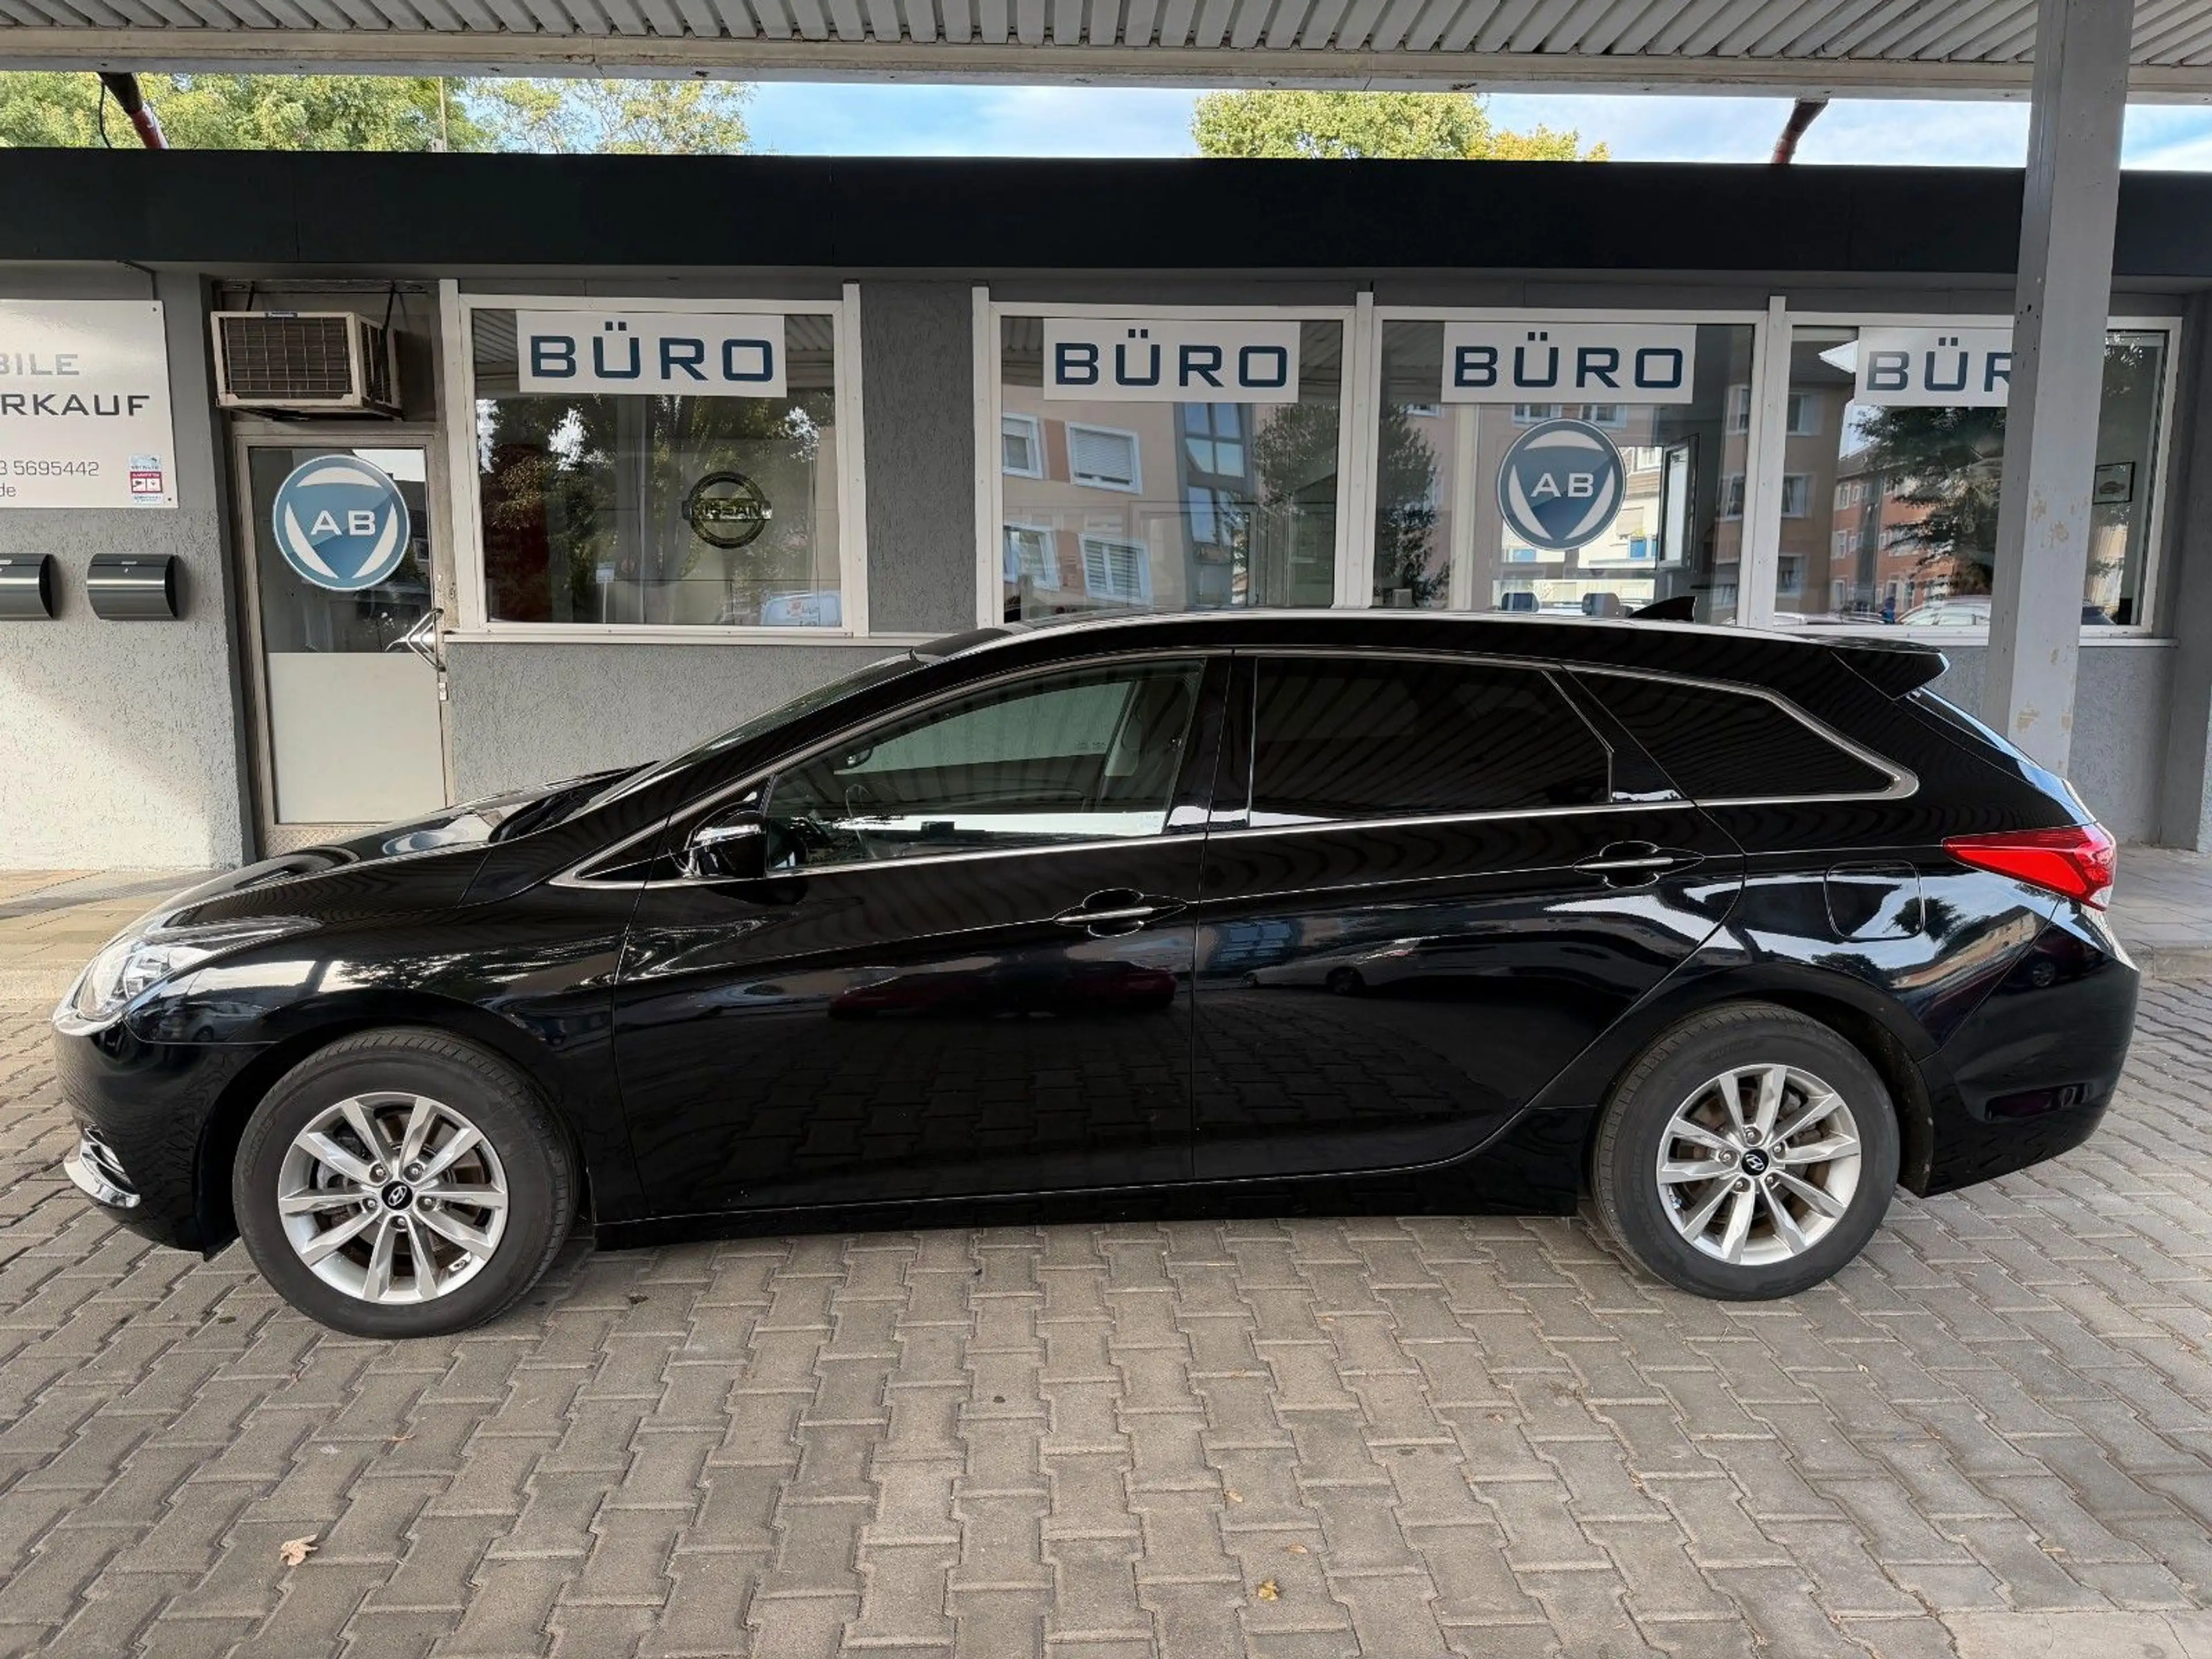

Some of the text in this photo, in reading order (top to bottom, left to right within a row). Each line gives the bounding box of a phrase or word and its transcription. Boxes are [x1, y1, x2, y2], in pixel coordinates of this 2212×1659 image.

[531, 321, 774, 382] BÜRO
[1055, 329, 1288, 388] BÜRO
[1455, 332, 1683, 389] BÜRO
[1866, 338, 2012, 392] BÜR
[1, 394, 150, 416] RKAUF
[14, 460, 100, 477] 5695442
[1531, 472, 1594, 498] AB
[310, 510, 376, 536] AB
